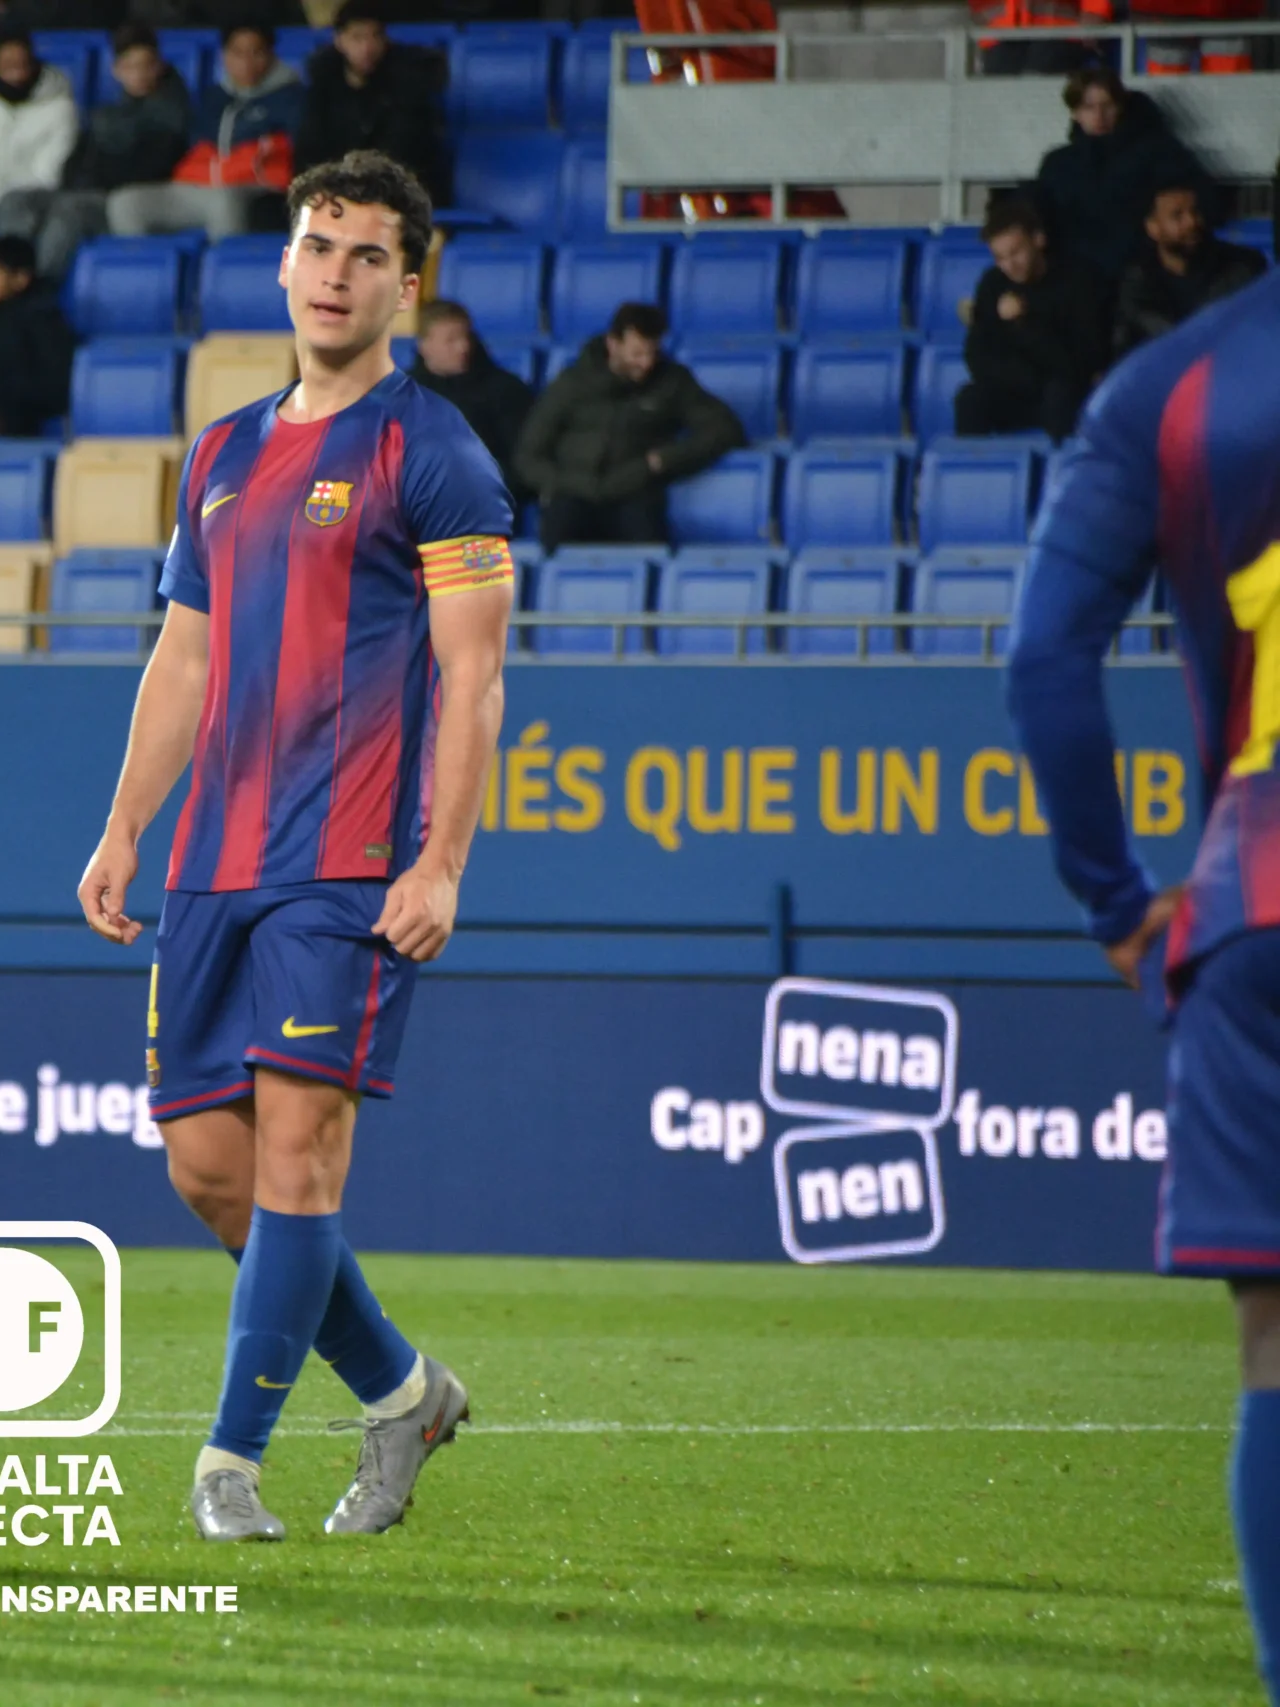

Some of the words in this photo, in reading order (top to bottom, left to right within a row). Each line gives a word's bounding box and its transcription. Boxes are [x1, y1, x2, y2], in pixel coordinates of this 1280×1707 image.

[625, 745, 797, 852] QUE
[820, 747, 940, 836] UN
[963, 746, 1185, 837] CLB
[778, 1020, 941, 1090] nena
[34, 1062, 166, 1149] jueg
[650, 1086, 764, 1164] Cap
[953, 1088, 1080, 1159] fora
[1091, 1091, 1168, 1161] de
[797, 1159, 923, 1223] nen
